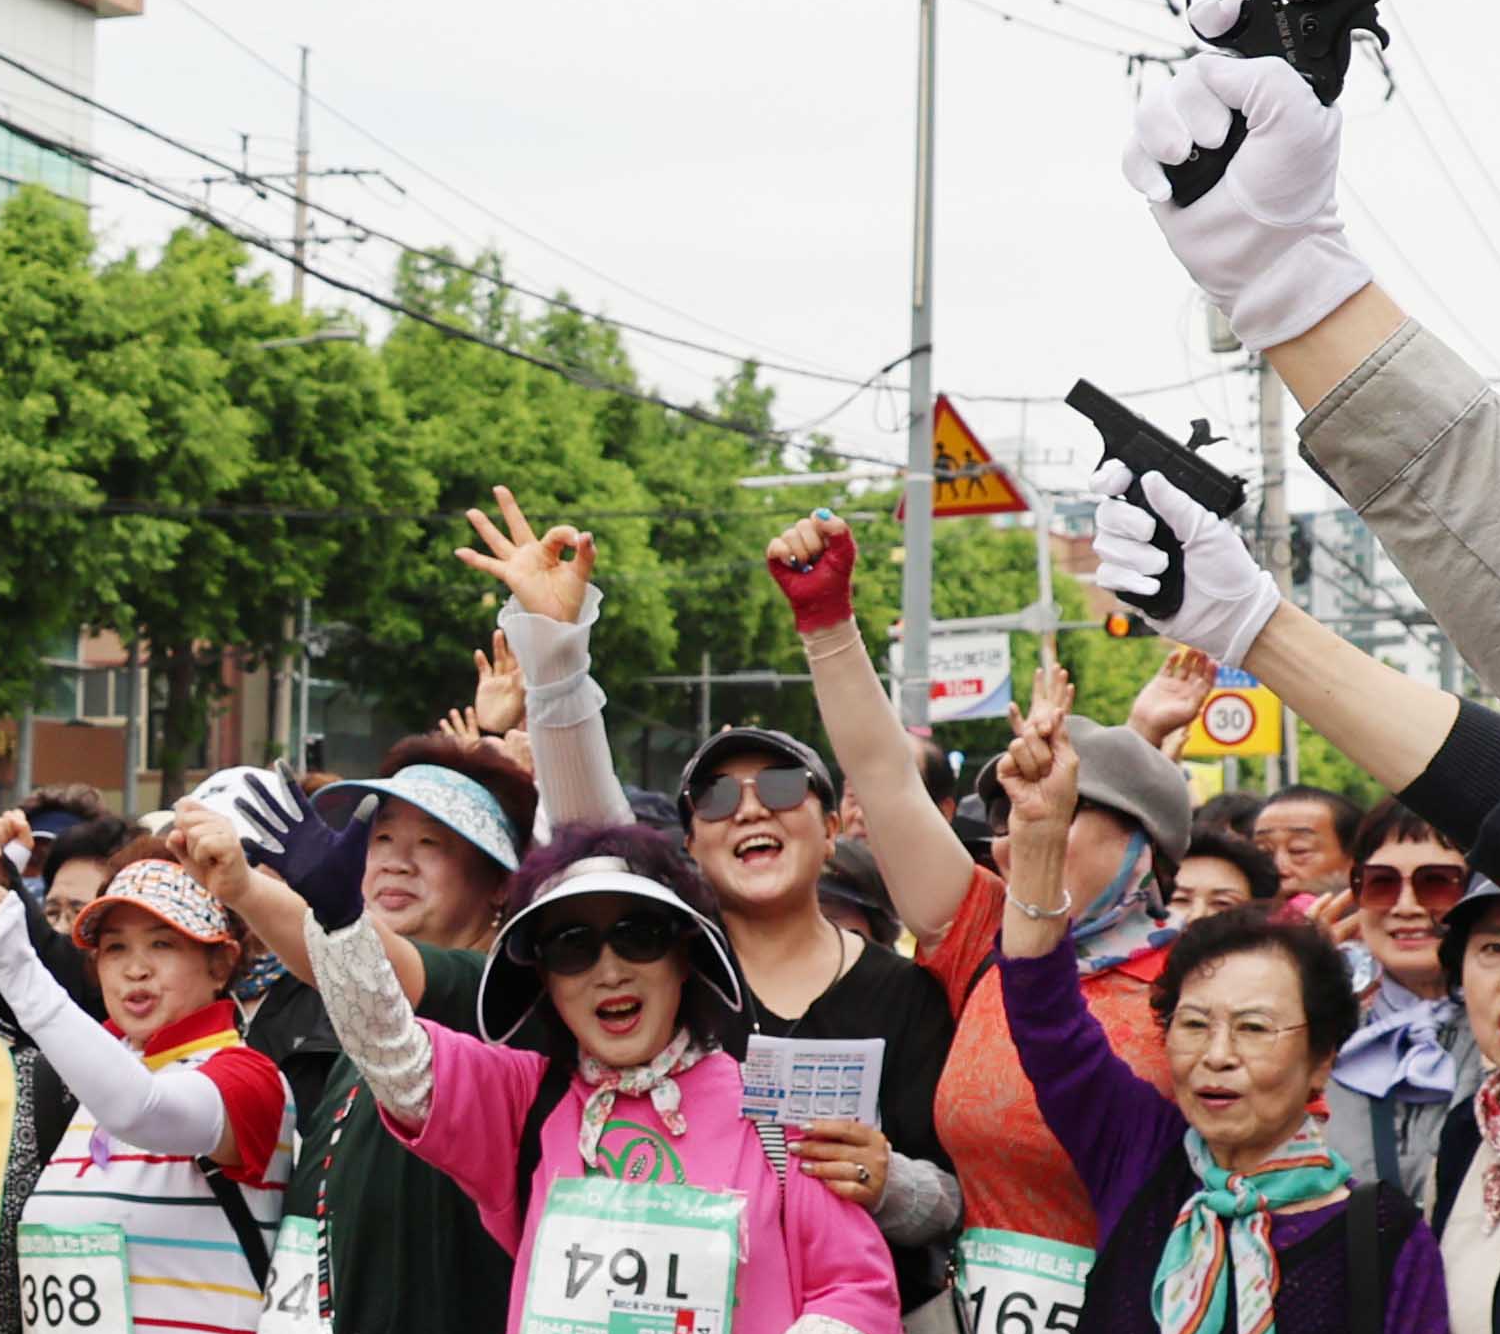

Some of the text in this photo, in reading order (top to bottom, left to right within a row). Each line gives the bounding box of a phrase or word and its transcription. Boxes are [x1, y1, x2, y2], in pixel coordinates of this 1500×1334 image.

[1212, 707, 1246, 731] 30
[564, 1242, 688, 1299] 164
[22, 1274, 102, 1327] 368
